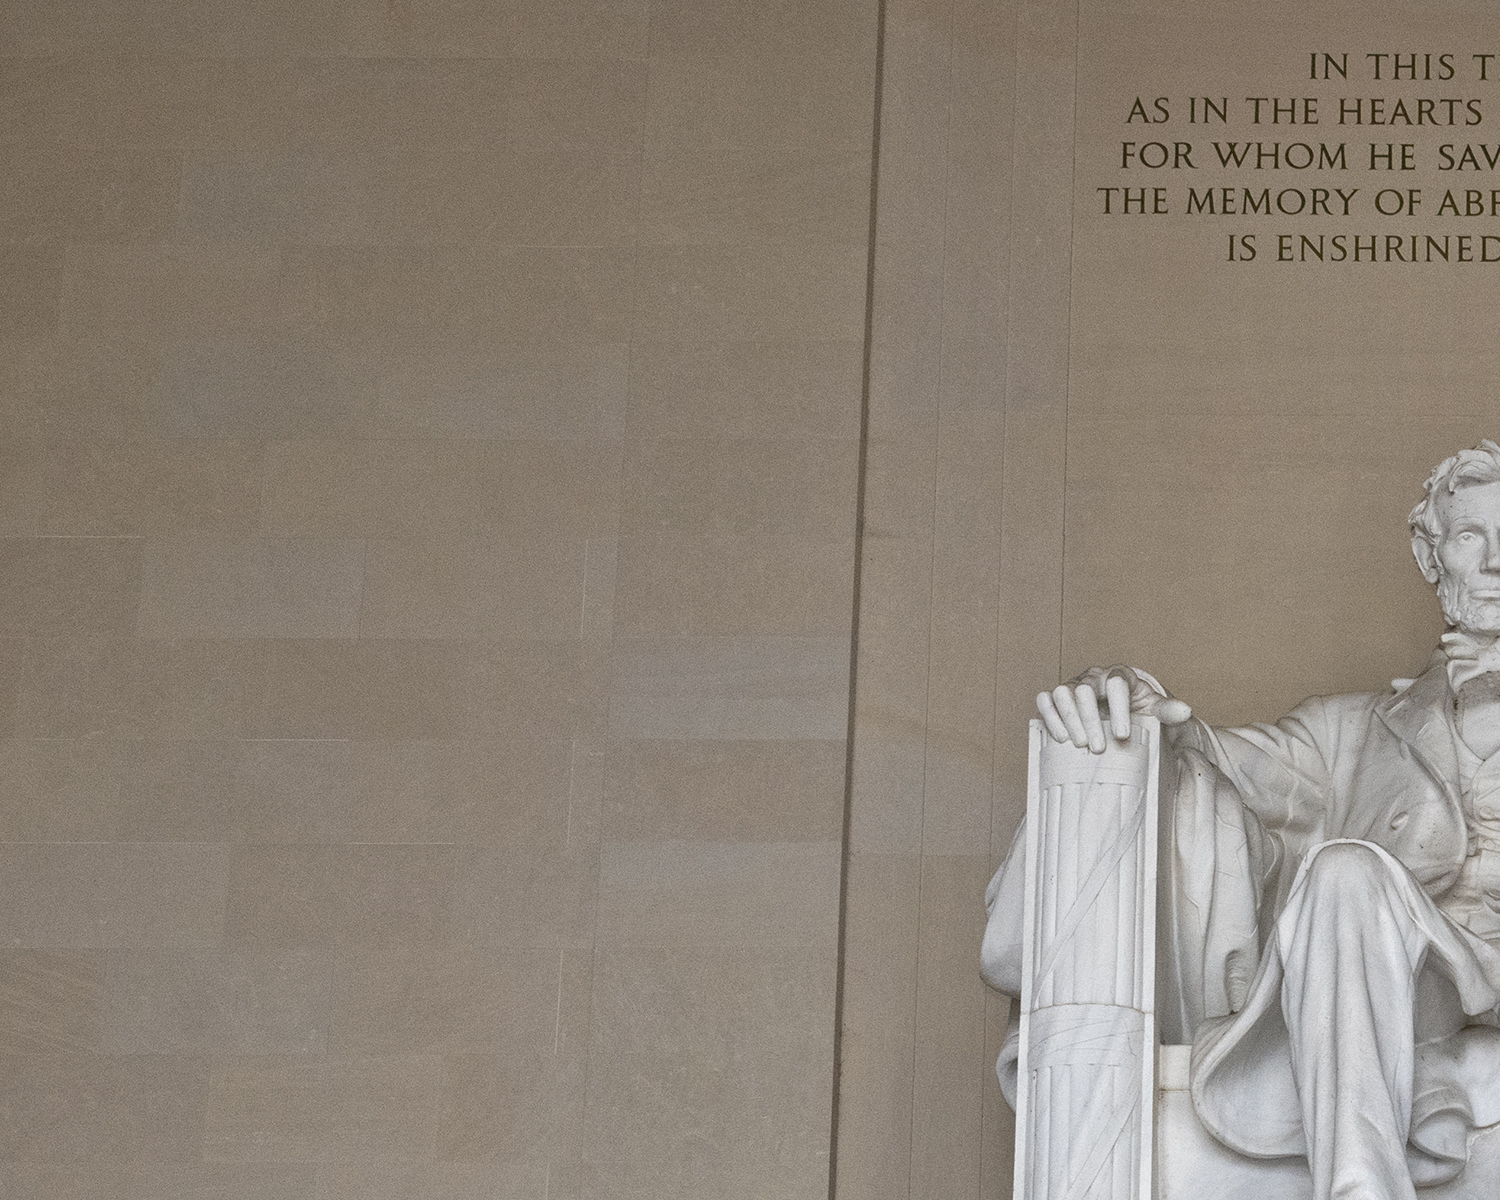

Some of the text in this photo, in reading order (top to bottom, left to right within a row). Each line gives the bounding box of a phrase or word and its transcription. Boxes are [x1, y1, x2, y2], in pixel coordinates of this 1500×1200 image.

[1310, 52, 1349, 80] IN
[1366, 53, 1455, 81] THIS
[1126, 96, 1170, 124] AS
[1189, 96, 1228, 124] IN
[1245, 97, 1319, 125] THE
[1338, 98, 1483, 126] HEARTS
[1121, 141, 1197, 169] FOR
[1211, 141, 1348, 171] WHOM
[1368, 142, 1416, 171] HE
[1096, 187, 1169, 215] THE
[1185, 187, 1360, 216] MEMORY
[1374, 188, 1422, 217] OF
[1227, 234, 1257, 262] IS
